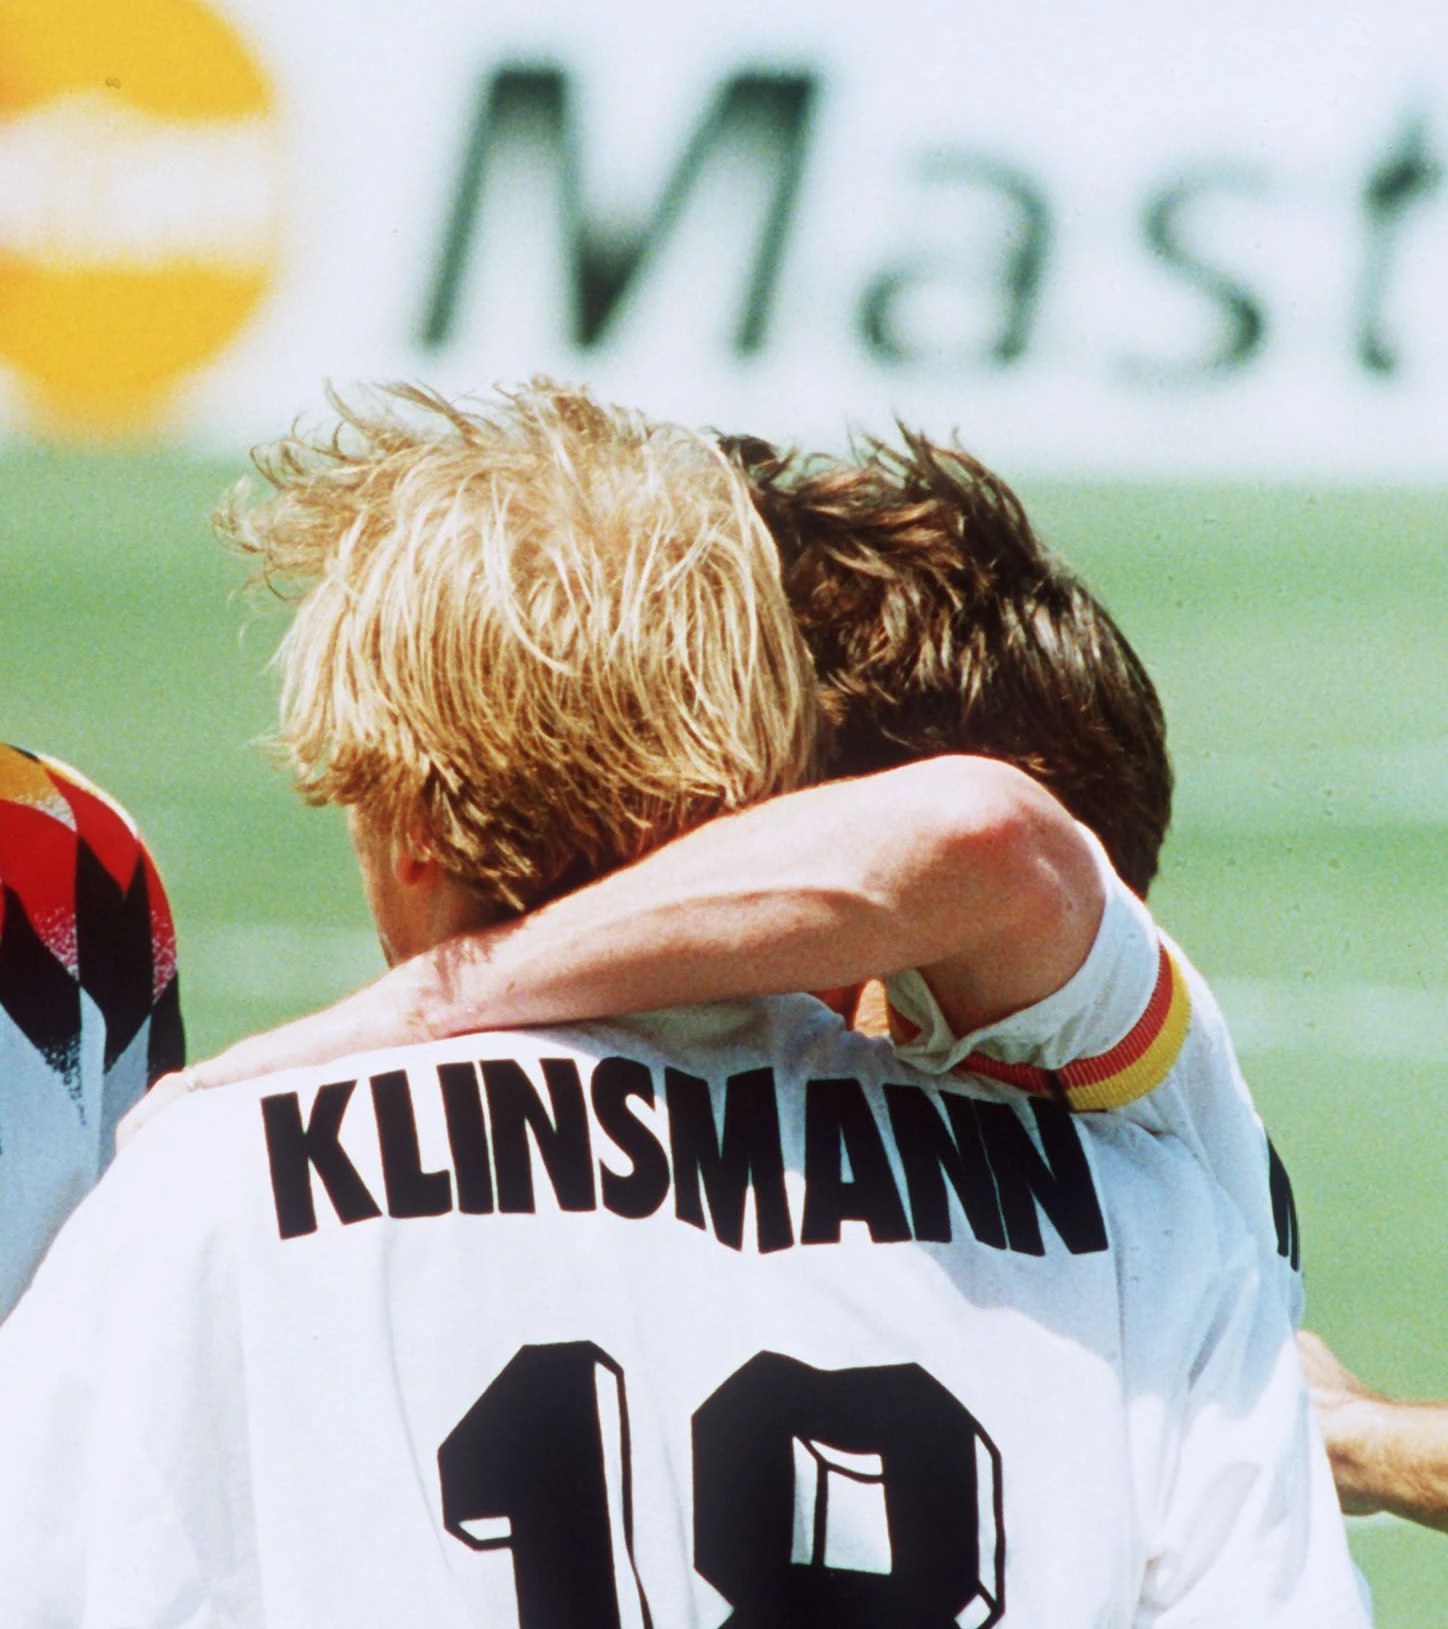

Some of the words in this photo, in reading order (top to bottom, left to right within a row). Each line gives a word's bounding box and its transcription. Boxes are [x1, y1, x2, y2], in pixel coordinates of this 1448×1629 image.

[420, 66, 1448, 378] Mast
[261, 1057, 1109, 1256] KLINSMANN
[438, 1341, 1007, 1629] 18
